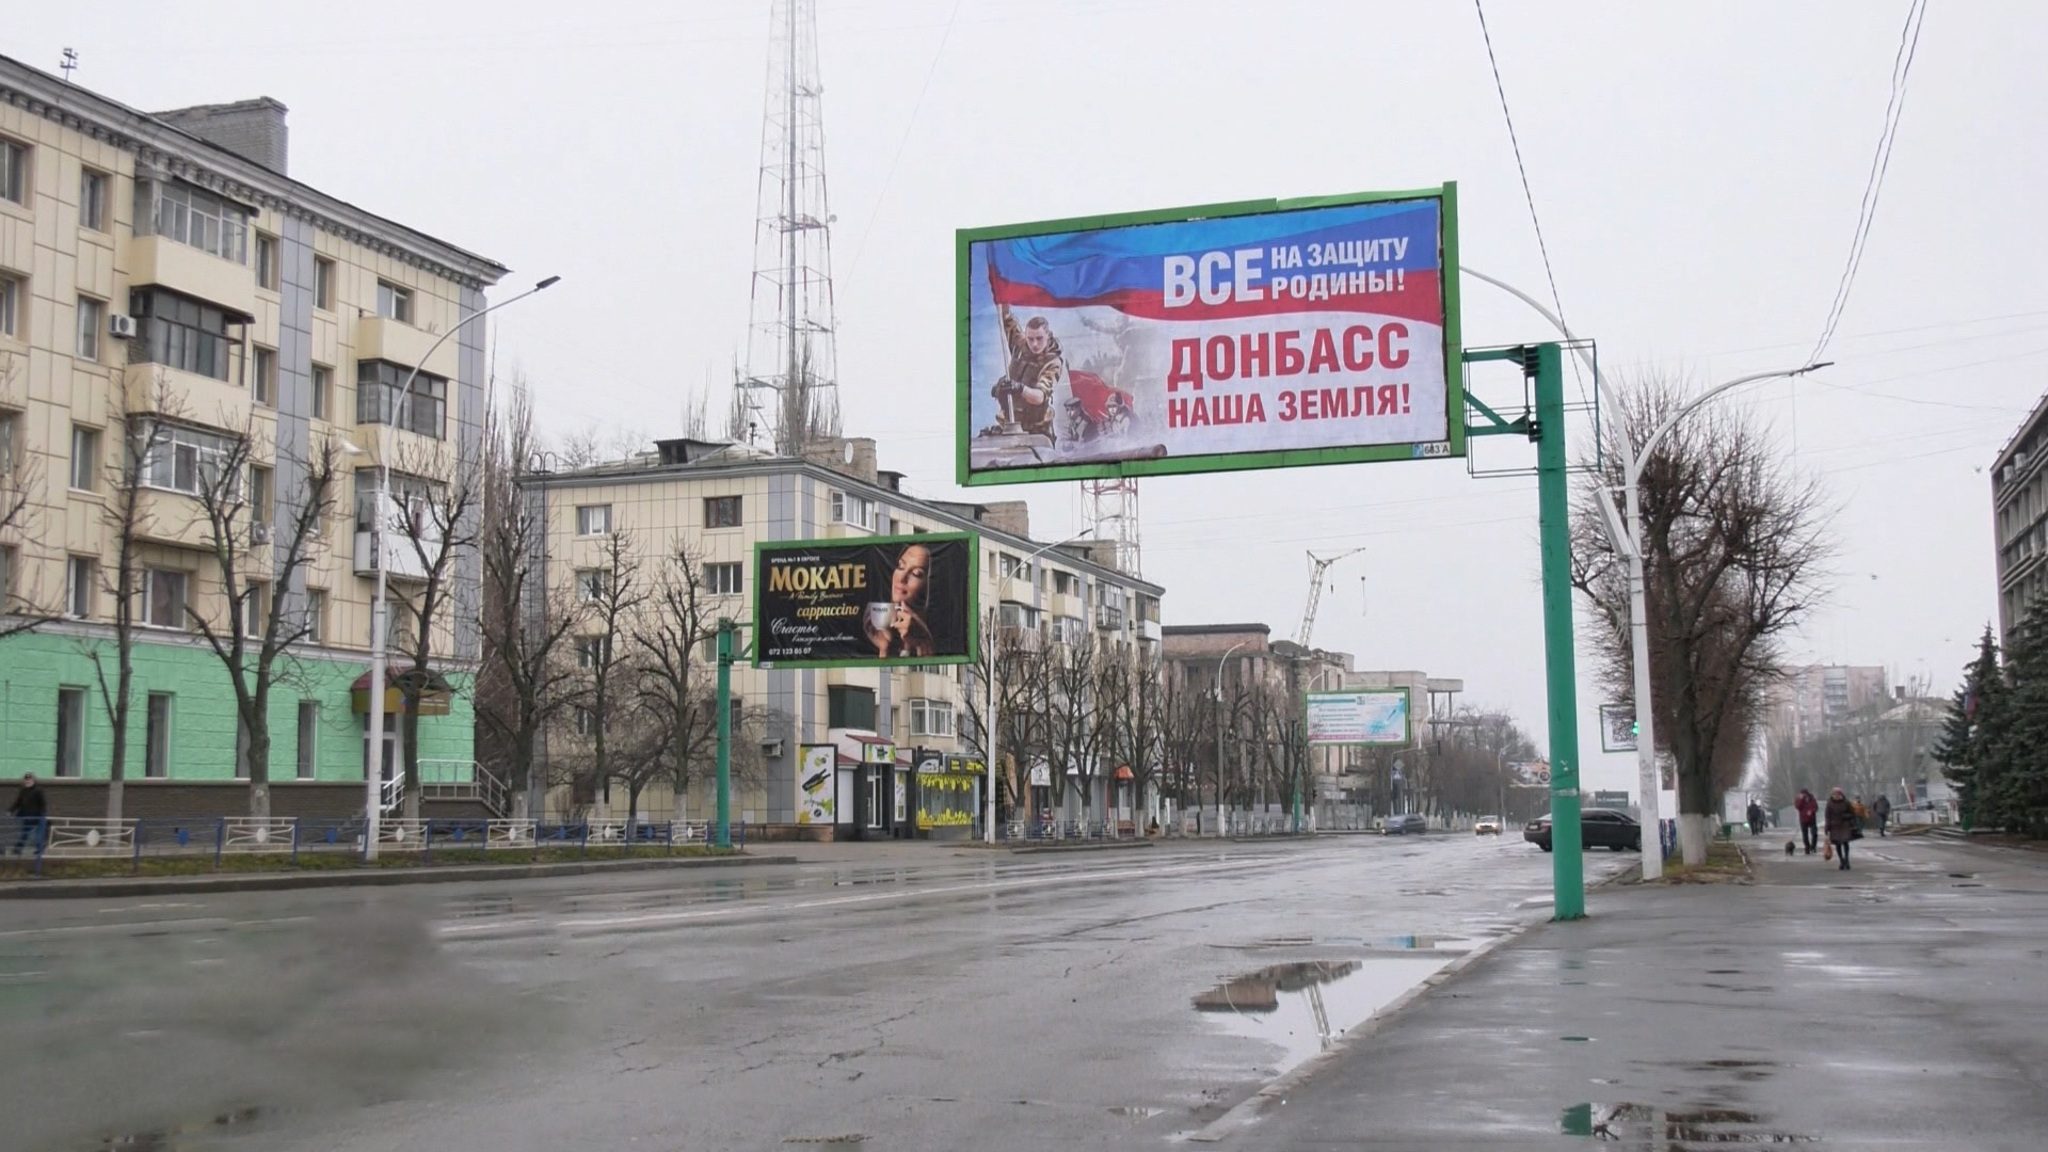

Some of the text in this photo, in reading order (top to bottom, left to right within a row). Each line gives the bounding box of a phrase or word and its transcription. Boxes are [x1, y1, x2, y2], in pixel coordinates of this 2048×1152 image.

[1164, 237, 1409, 308] ВСЕ НА ЗАЩИТУ
[1271, 268, 1405, 301] РОДИНЫ!
[1167, 322, 1410, 392] ДОНБАСС
[1169, 383, 1410, 428] НАША ЗЕМЛЯ!
[769, 563, 866, 592] MOKATE
[770, 617, 819, 636] Счастье
[796, 603, 860, 620] cappuccino
